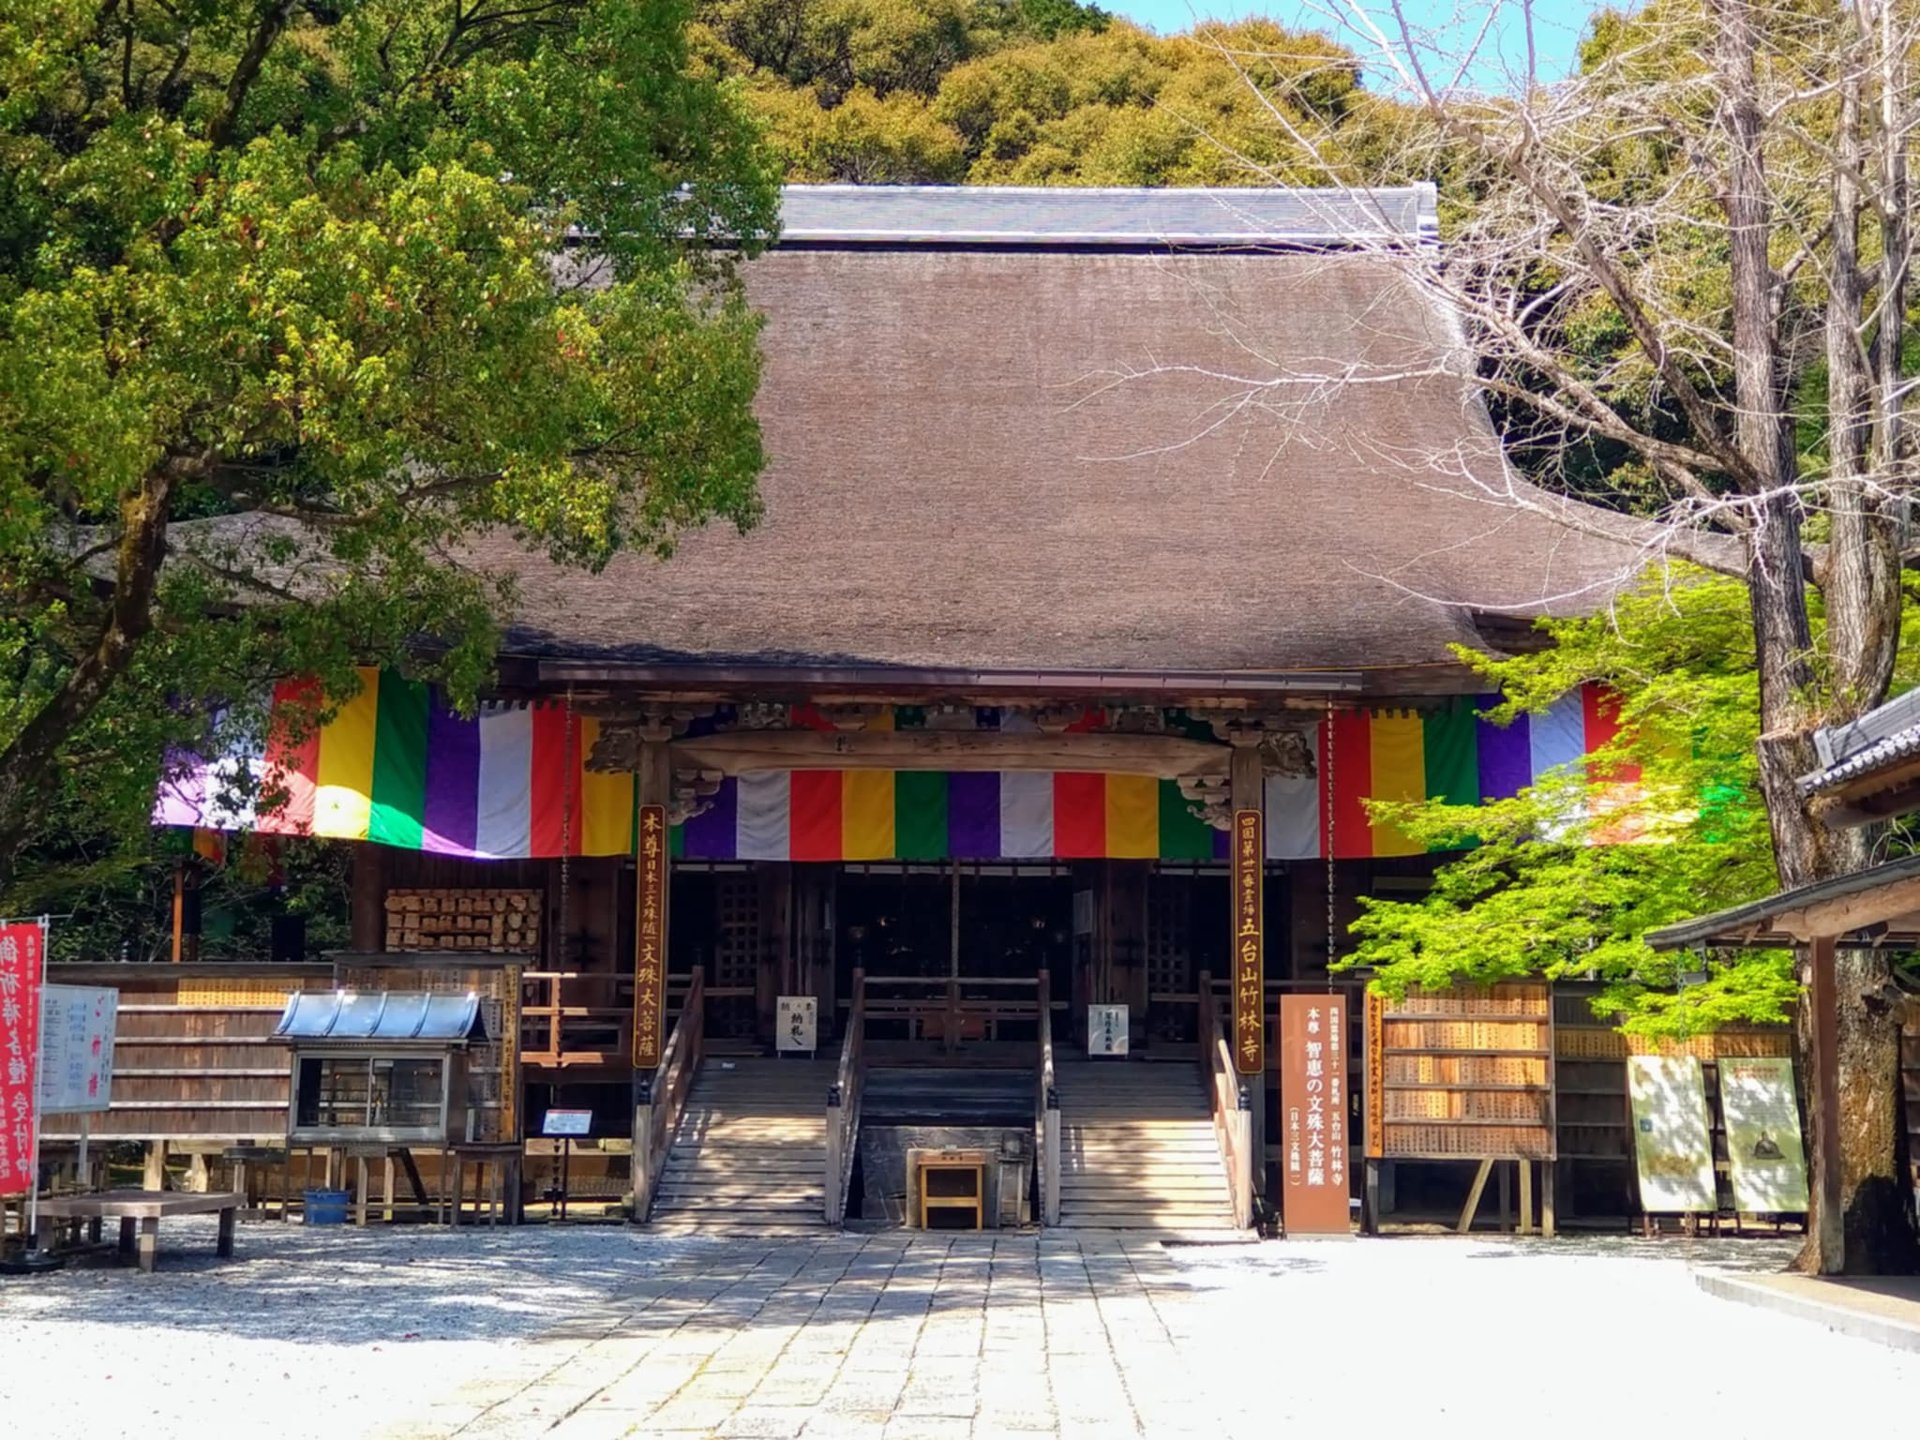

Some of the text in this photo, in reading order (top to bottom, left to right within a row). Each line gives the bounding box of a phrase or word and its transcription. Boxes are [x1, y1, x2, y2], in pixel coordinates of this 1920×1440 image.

[1305, 1006, 1325, 1186] 本尊 智恵の文殊大菩薩
[1331, 1145, 1344, 1187] 竹林寺
